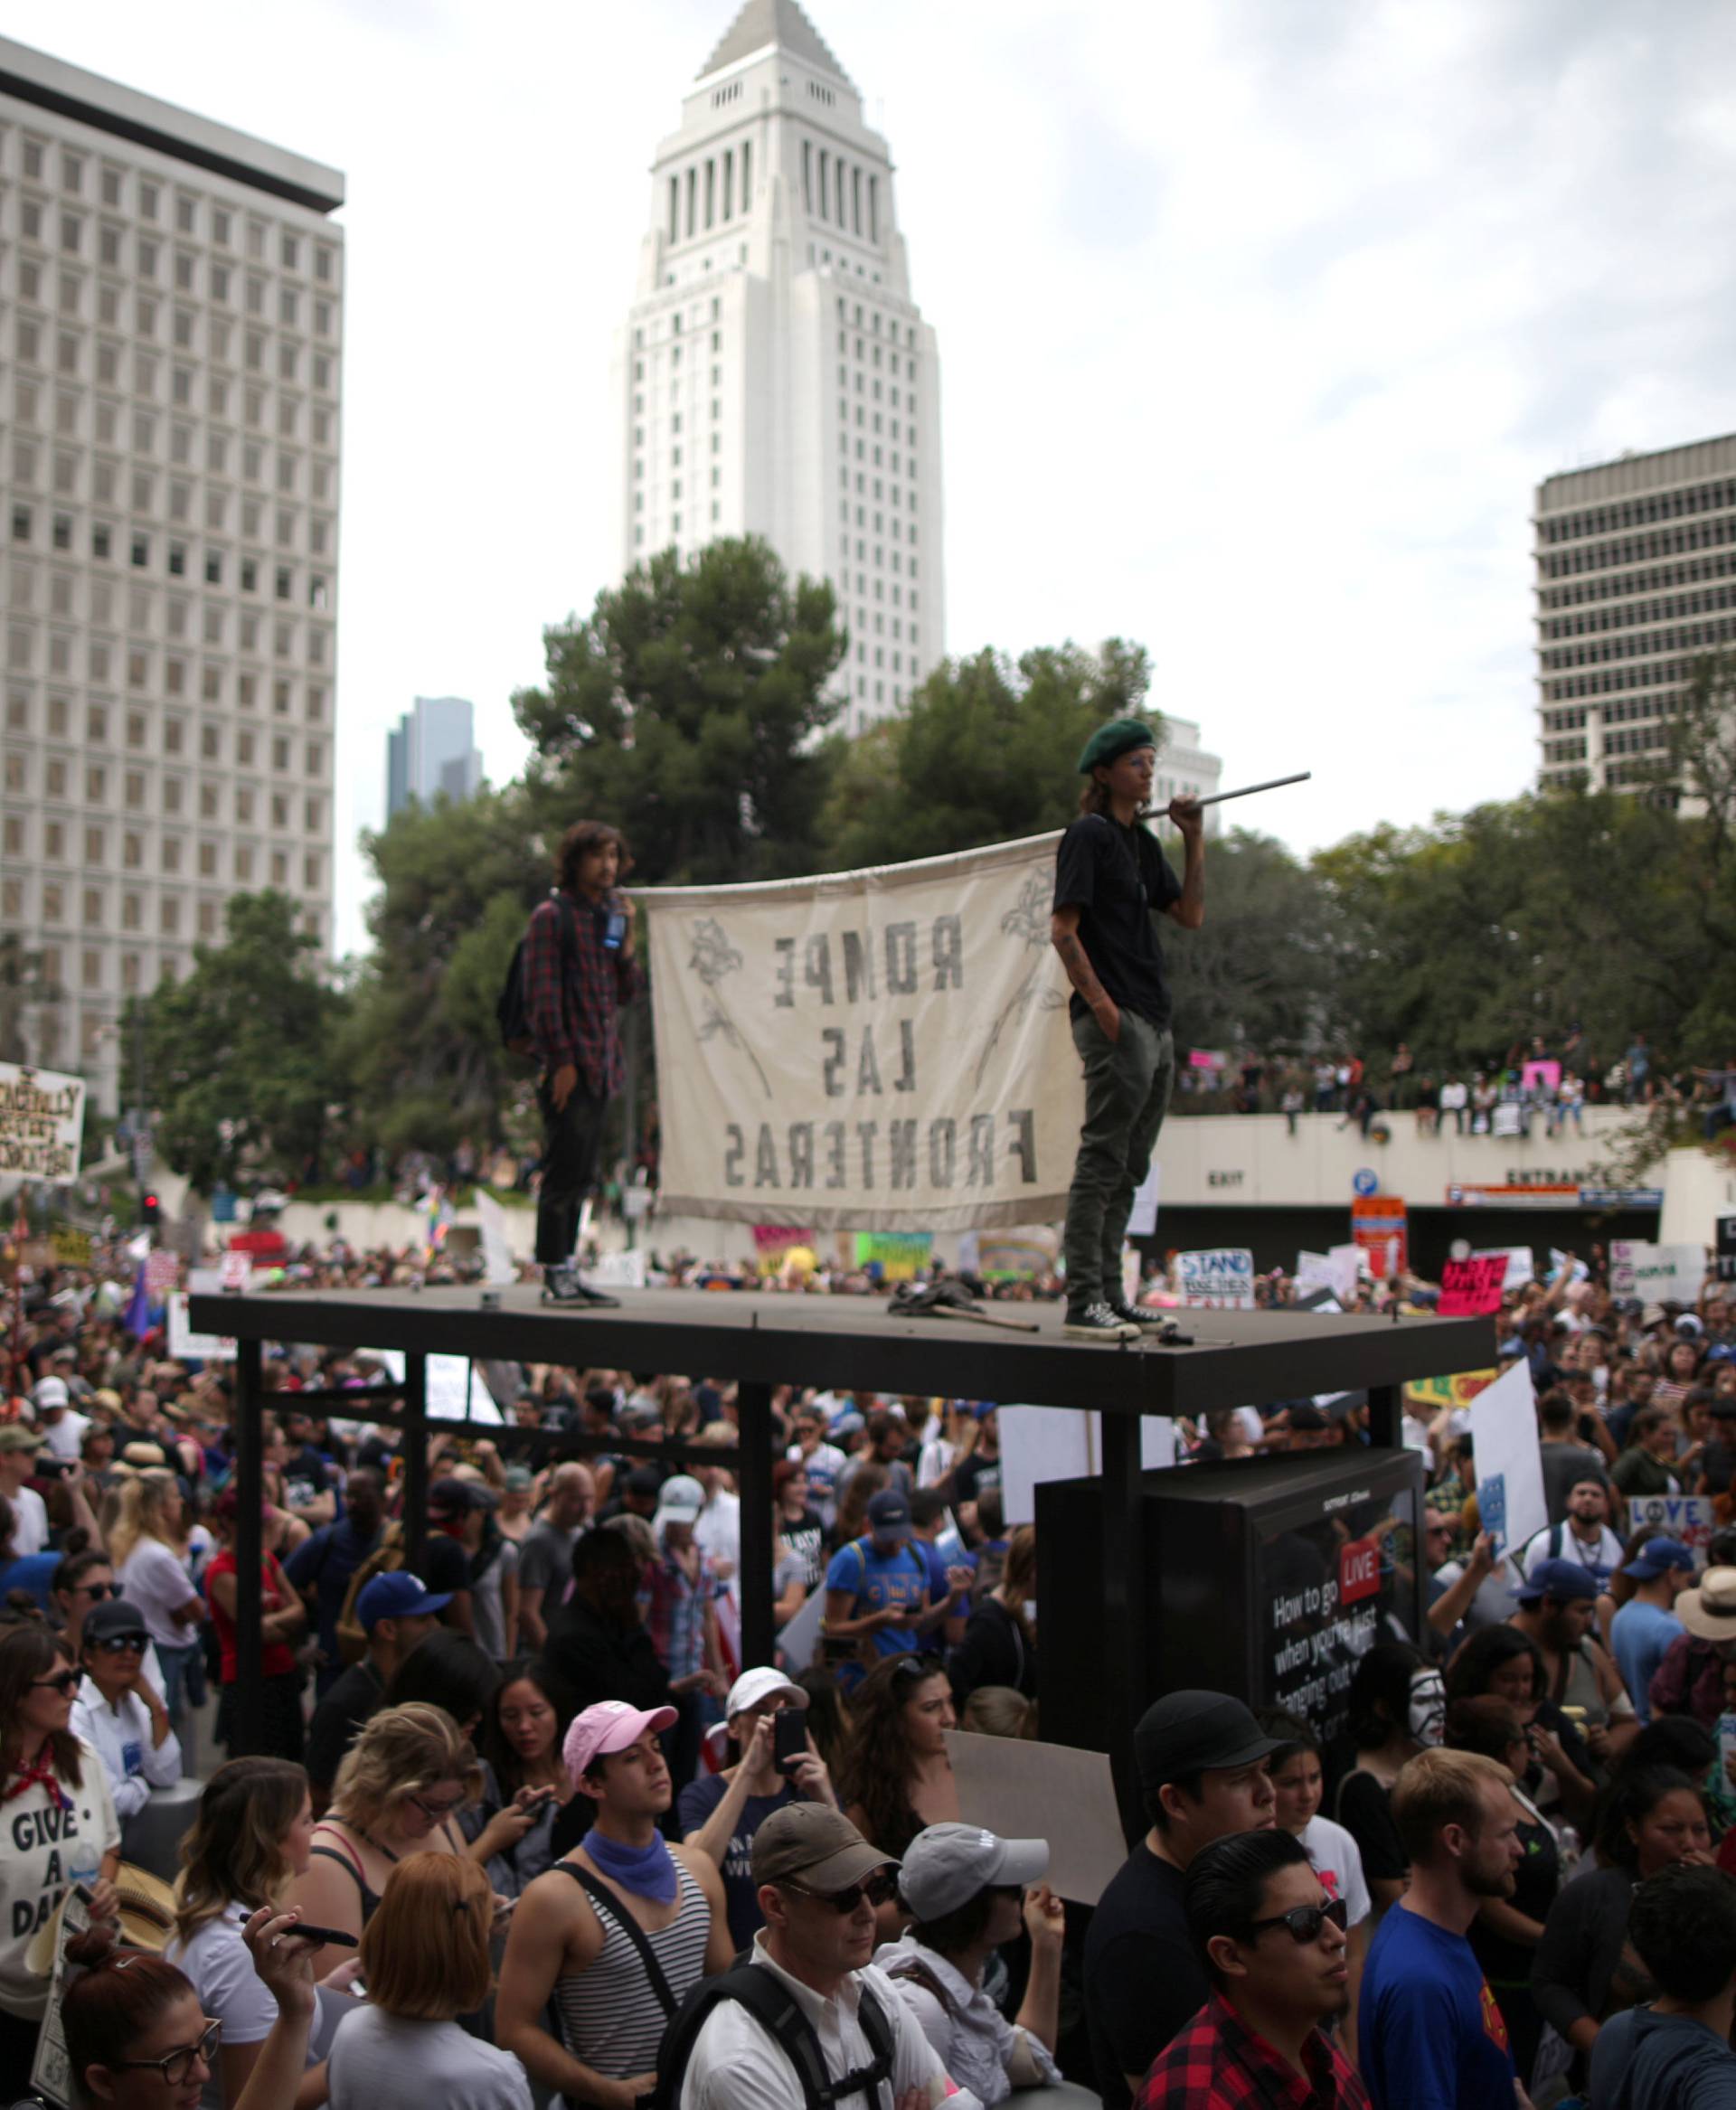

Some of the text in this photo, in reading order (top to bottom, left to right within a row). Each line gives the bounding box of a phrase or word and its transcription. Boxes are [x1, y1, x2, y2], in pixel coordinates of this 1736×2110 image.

[1208, 1172, 1244, 1187] EXIT
[1182, 1254, 1250, 1277] STAND
[1633, 1500, 1703, 1525] LOVE
[1273, 1550, 1374, 1627] How to go LIVE
[1275, 1638, 1310, 1675] when
[1328, 1661, 1351, 1692] out
[12, 1806, 79, 1851] GIVE
[42, 1850, 62, 1888] A
